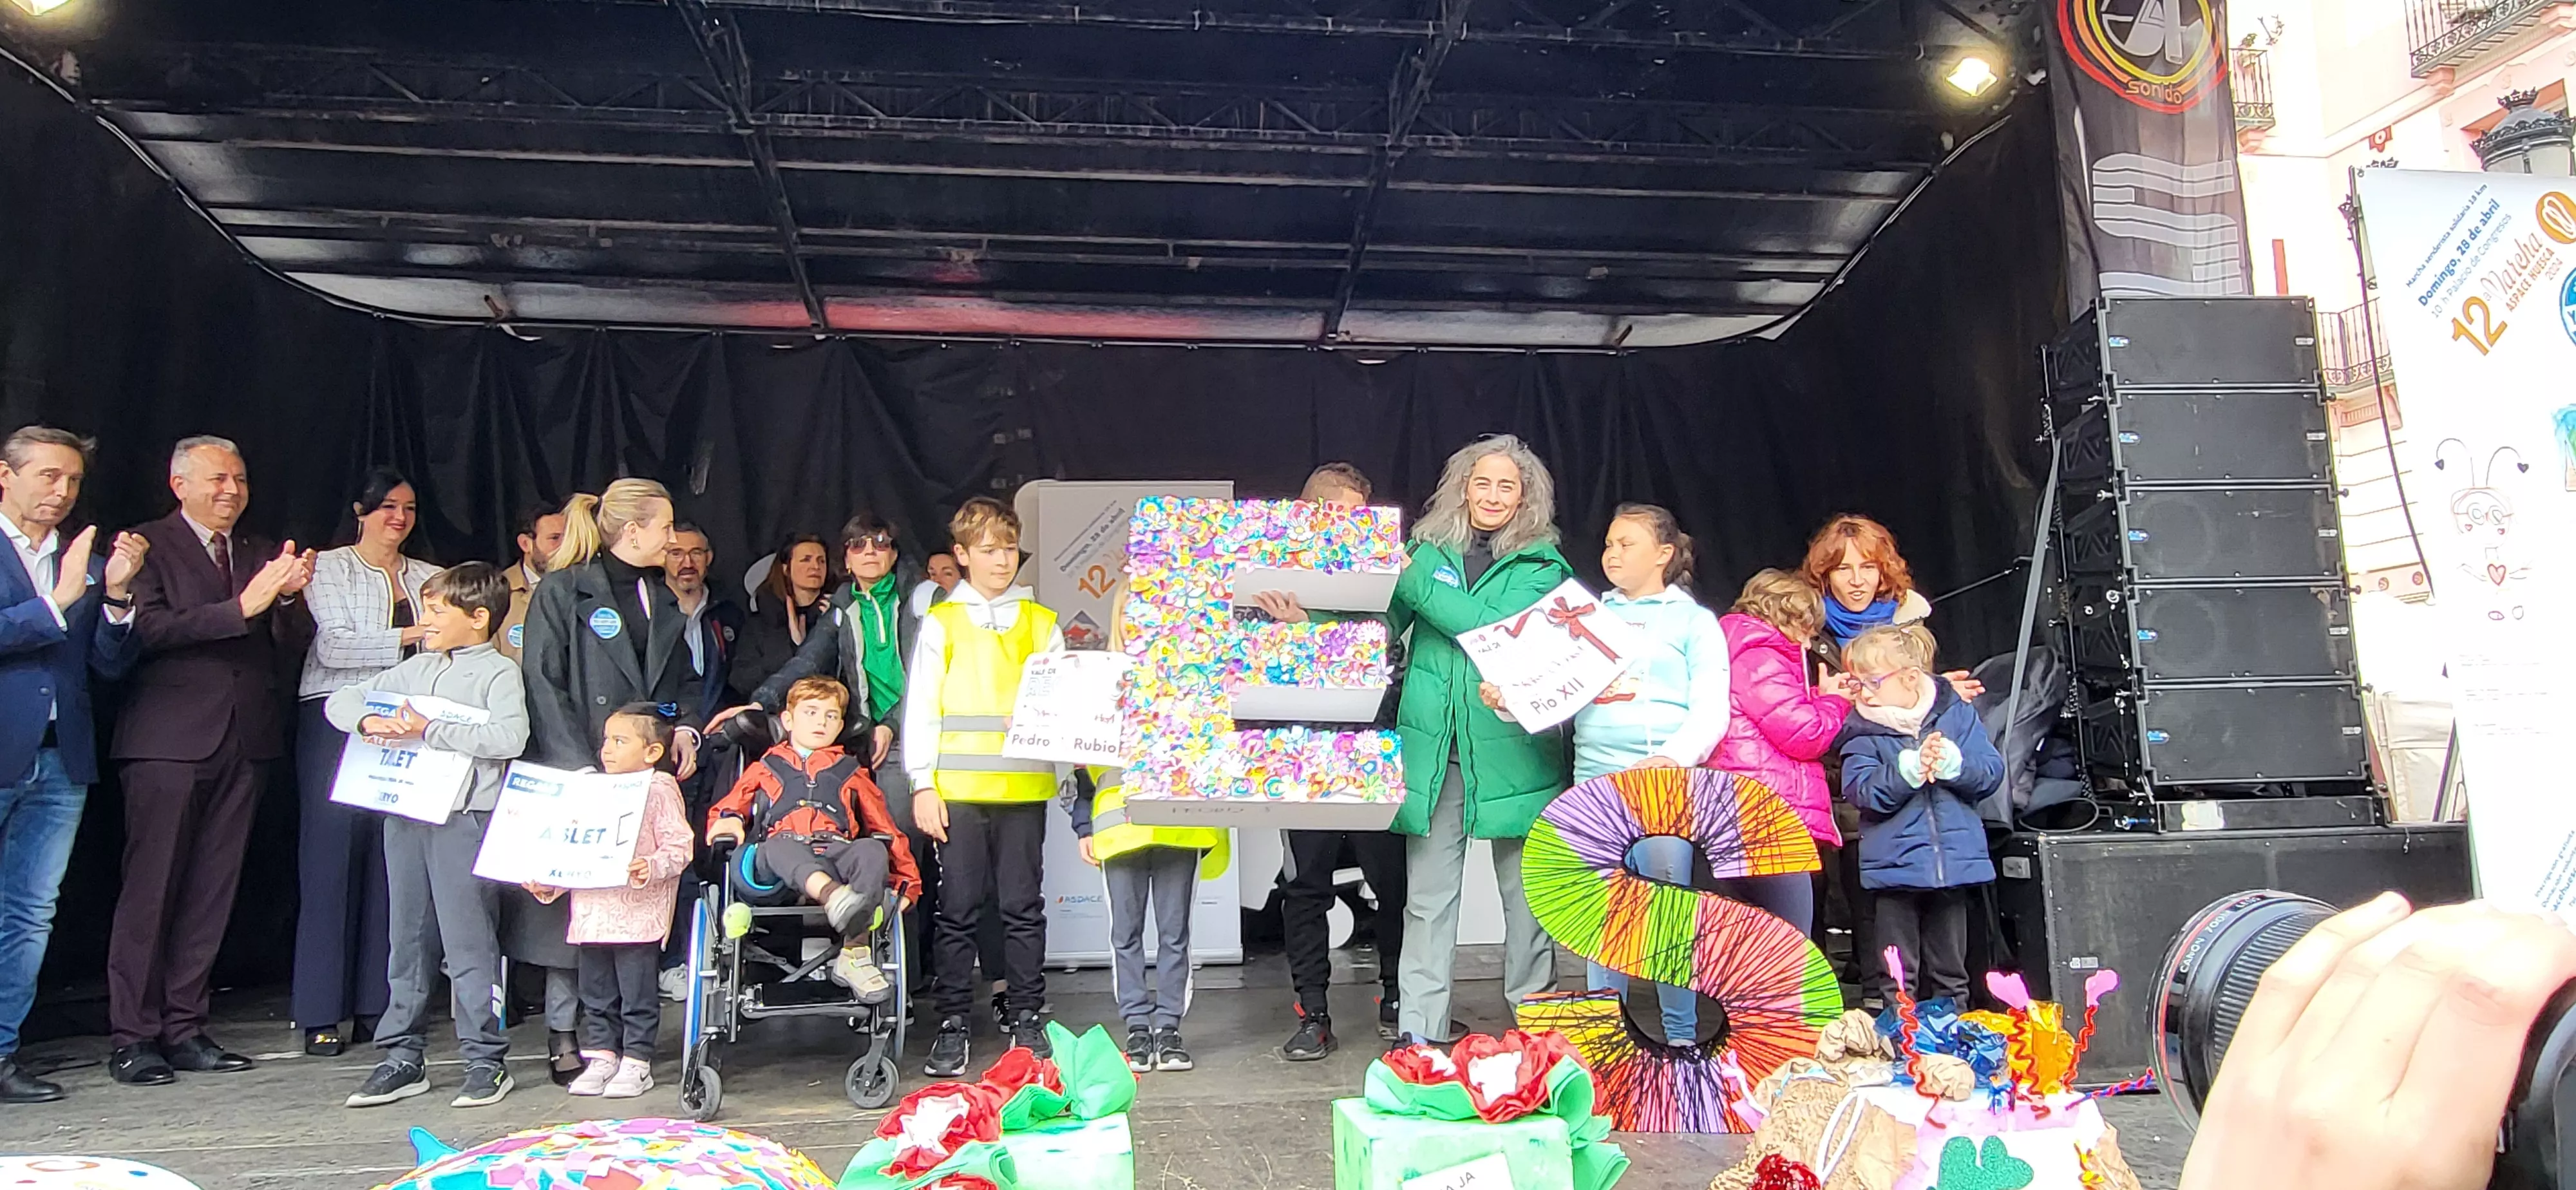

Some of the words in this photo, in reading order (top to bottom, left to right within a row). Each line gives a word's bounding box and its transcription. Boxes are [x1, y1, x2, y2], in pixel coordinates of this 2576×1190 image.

[2126, 80, 2183, 104] sonido
[2476, 184, 2488, 196] km
[2418, 257, 2461, 307] Domingo,
[2456, 239, 2470, 256] 28
[2468, 225, 2482, 241] de
[2479, 198, 2500, 227] abril
[2430, 304, 2443, 319] 10
[2447, 266, 2472, 298] Palacio
[2470, 254, 2481, 267] de
[2477, 213, 2512, 256] Congresos
[2505, 278, 2532, 312] ASPACE
[2528, 247, 2555, 281] HUESCA
[1078, 565, 1116, 599] 12
[1557, 677, 1584, 701] XII
[1012, 733, 1050, 747] Pedro
[1074, 737, 1116, 753] Rubio
[2179, 937, 2205, 973] CANON
